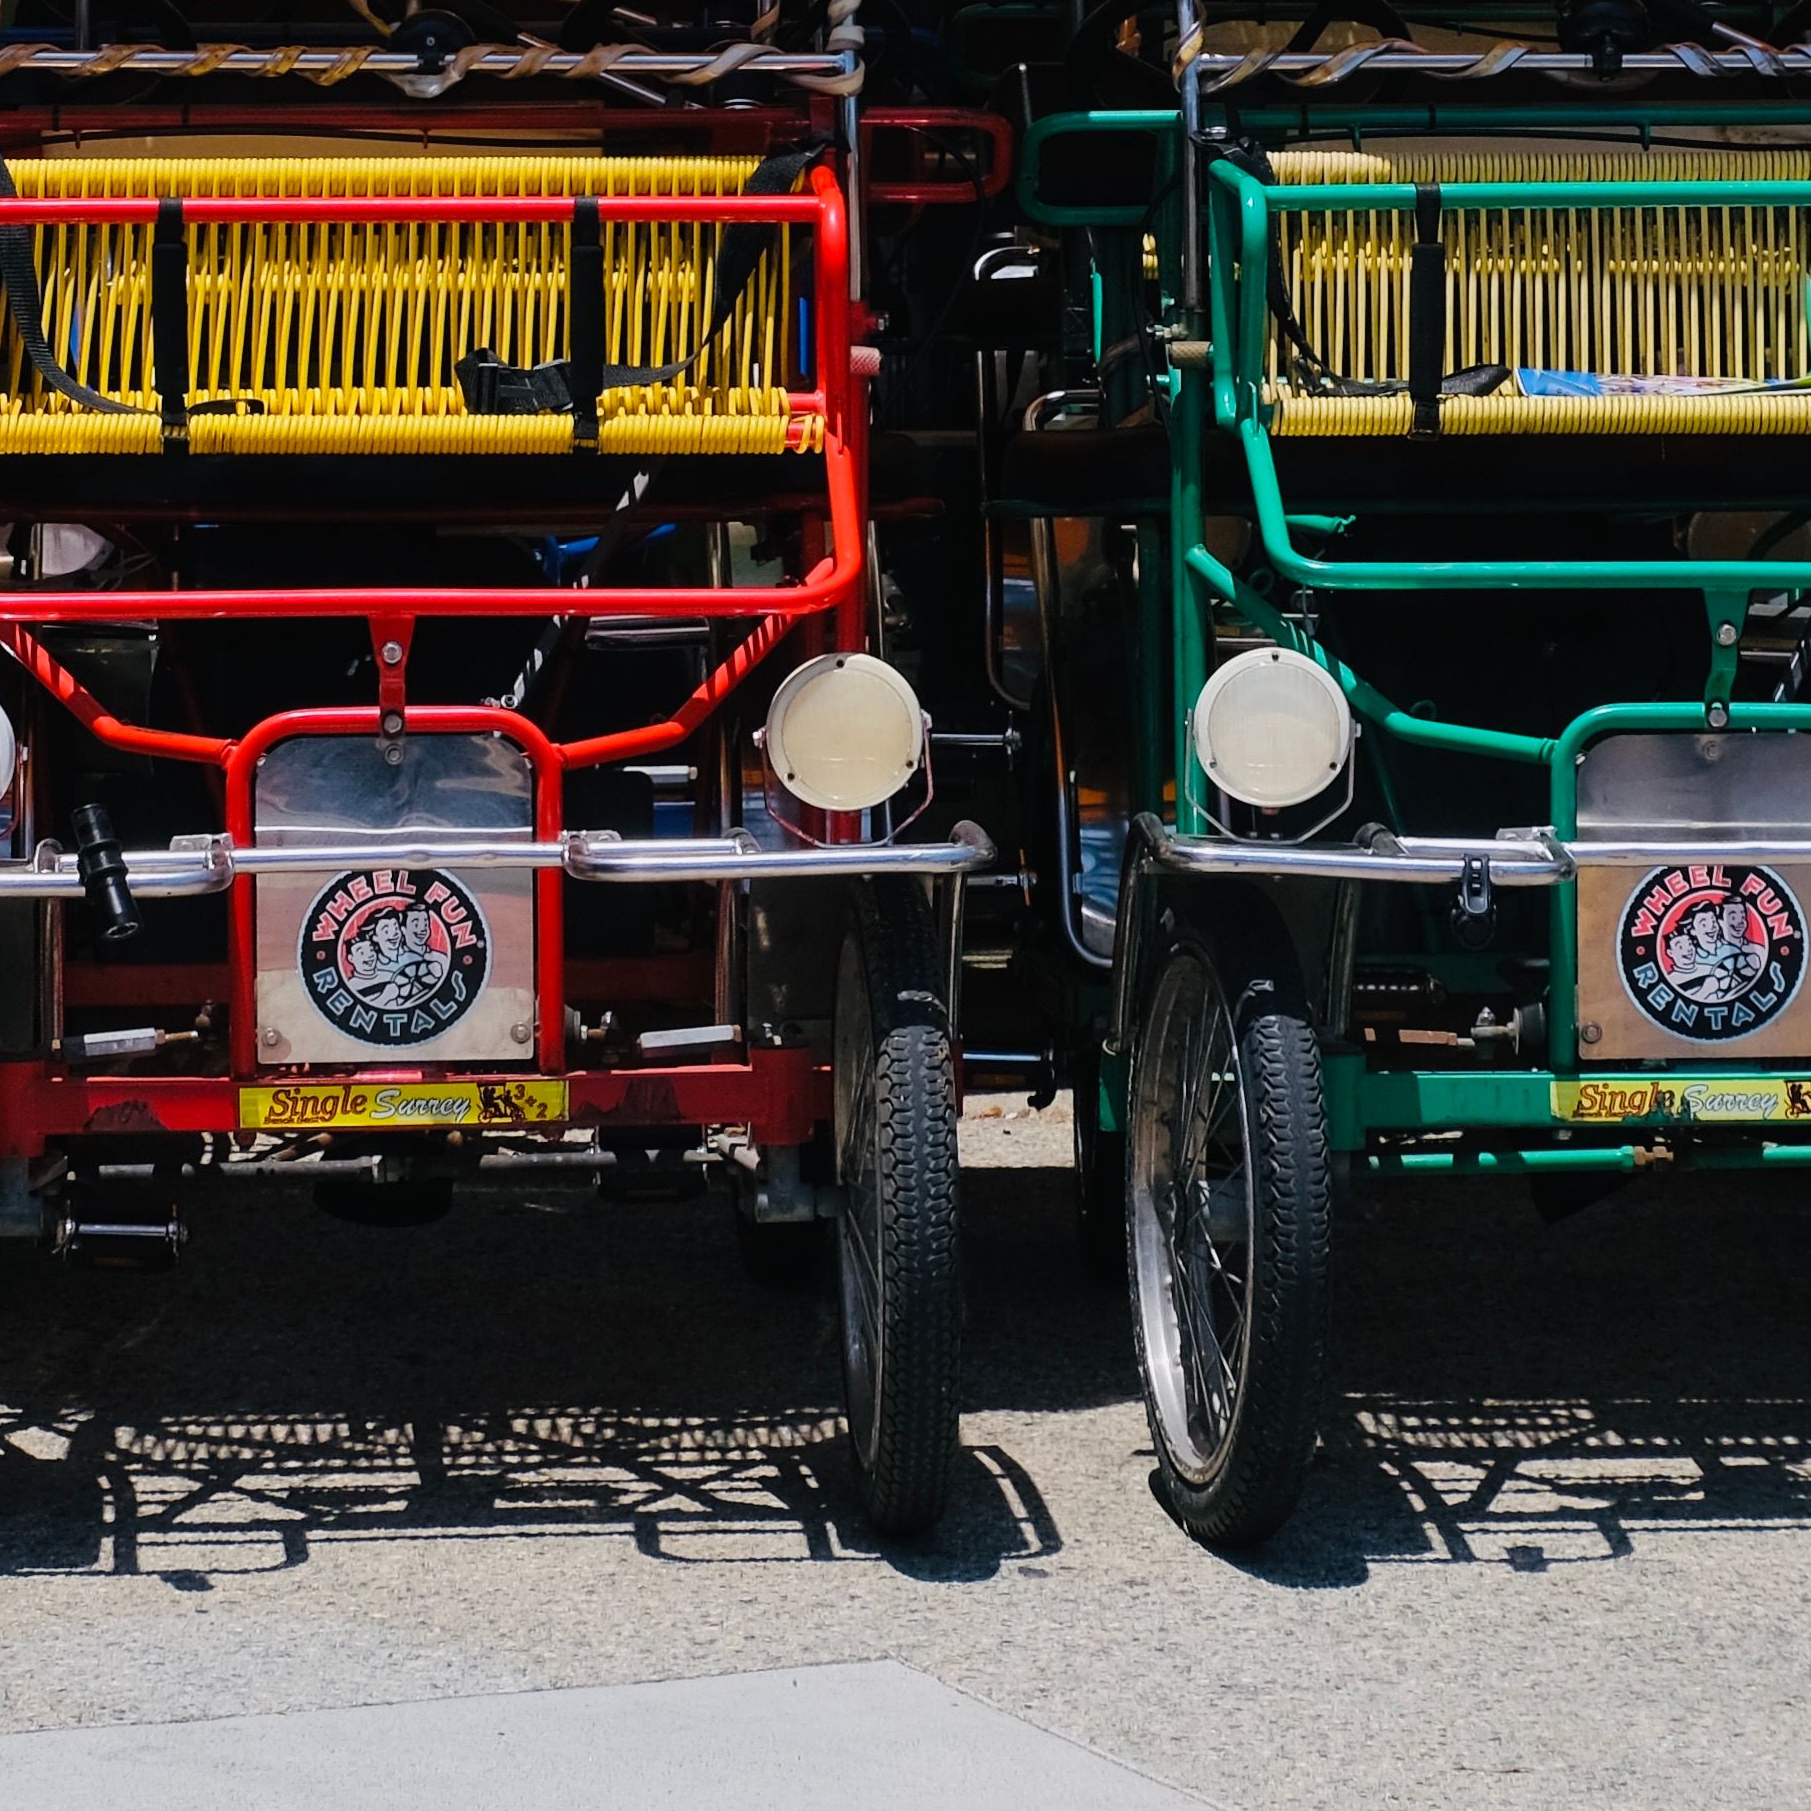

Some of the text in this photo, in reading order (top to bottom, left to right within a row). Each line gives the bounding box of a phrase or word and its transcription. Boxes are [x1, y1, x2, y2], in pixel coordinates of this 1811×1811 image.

[312, 869, 477, 949] WHEEL FUN
[1631, 865, 1794, 940] WHEEL FUN
[313, 966, 467, 1036] RENTALS
[1633, 961, 1786, 1030] RENTALS
[268, 1084, 471, 1123] Single Surrey
[1682, 1084, 1779, 1120] Surrey
